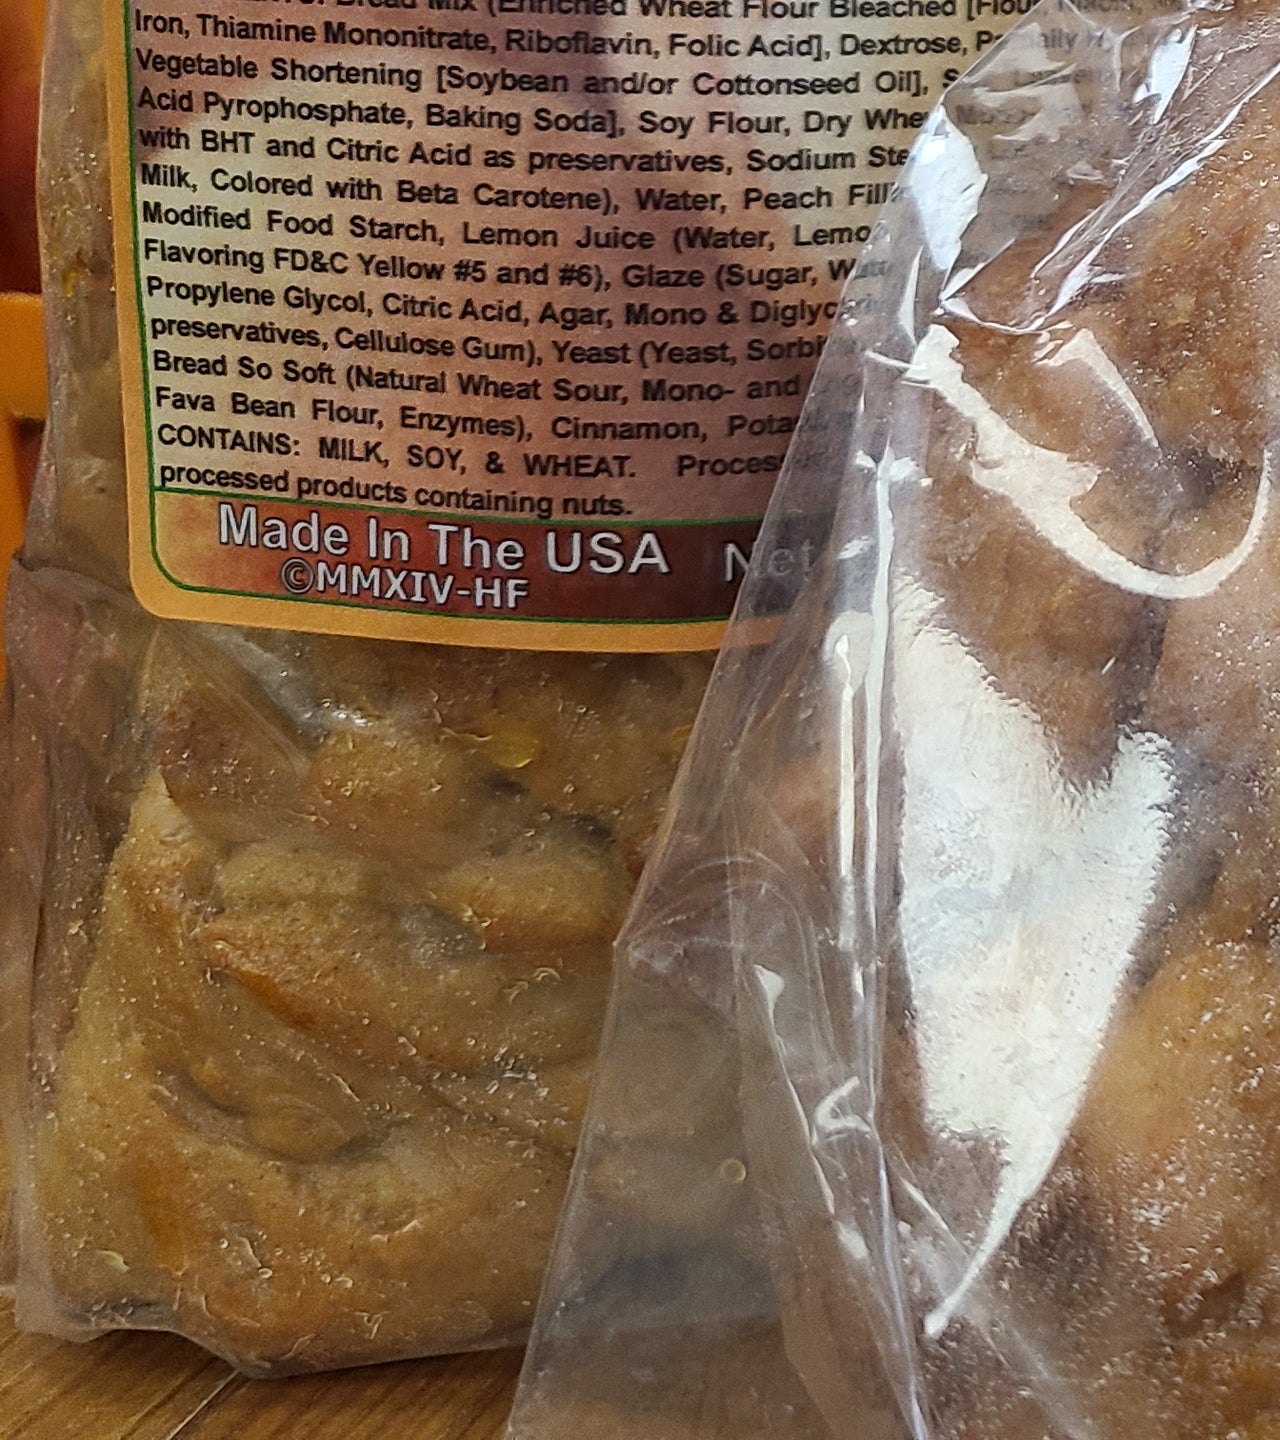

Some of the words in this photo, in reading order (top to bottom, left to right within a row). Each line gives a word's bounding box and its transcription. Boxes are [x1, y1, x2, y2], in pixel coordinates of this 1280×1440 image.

[135, 11, 189, 38] Iron,
[197, 16, 316, 43] Thiamine
[324, 25, 496, 54] Mononitrate,
[505, 30, 660, 57] Riboflavin,
[669, 33, 741, 57] Folic
[747, 34, 828, 62] Acid],
[839, 34, 969, 57] Dextrose,
[138, 130, 189, 153] with
[202, 132, 254, 156] BHT
[266, 137, 316, 160] and
[326, 138, 399, 163] Citric
[409, 143, 471, 167] Acid
[484, 151, 513, 169] as
[529, 148, 732, 175] preservatives,
[746, 151, 857, 173] Sodium
[144, 238, 263, 273] Flavoring
[275, 247, 348, 274] FD&C
[358, 254, 444, 280] Yellow
[454, 262, 486, 281] #5
[496, 263, 547, 285] and
[559, 265, 611, 290] #6),
[623, 266, 705, 288] Glaze
[716, 265, 818, 291] (Sugar,
[158, 424, 300, 457] CONTAINS:
[318, 438, 389, 468] MILK,
[406, 444, 465, 472] SOY,
[486, 452, 503, 474] &
[523, 454, 634, 479] WHEAT.
[159, 463, 289, 493] processed
[298, 476, 408, 504] products
[414, 484, 552, 518] containing
[562, 493, 632, 516] nuts.
[218, 502, 348, 555] Made
[368, 516, 409, 560] In
[429, 524, 525, 571] The
[546, 532, 670, 576] USA
